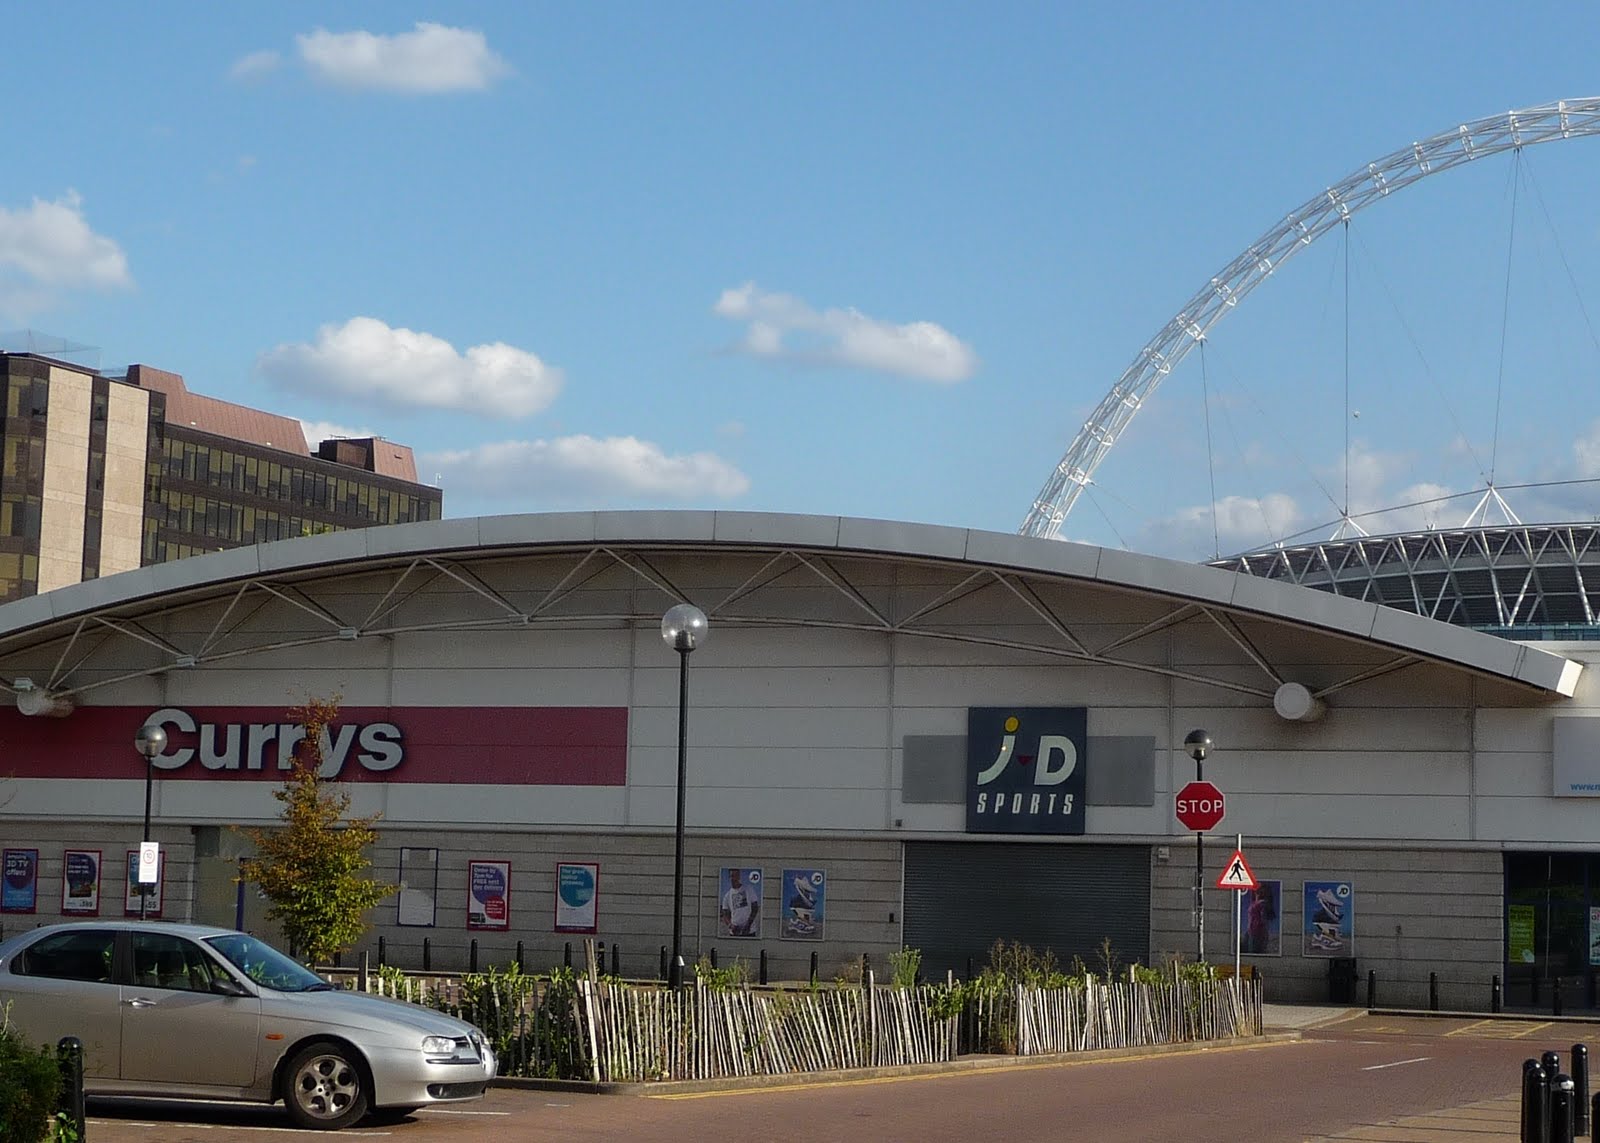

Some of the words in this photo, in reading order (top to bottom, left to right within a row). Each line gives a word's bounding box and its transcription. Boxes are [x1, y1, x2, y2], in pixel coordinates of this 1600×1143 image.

[142, 708, 404, 778] Currys
[976, 792, 1074, 815] SPORTS
[1177, 799, 1223, 813] STOP
[6, 860, 17, 868] 3D
[19, 860, 29, 868] TV
[6, 868, 27, 877] offers
